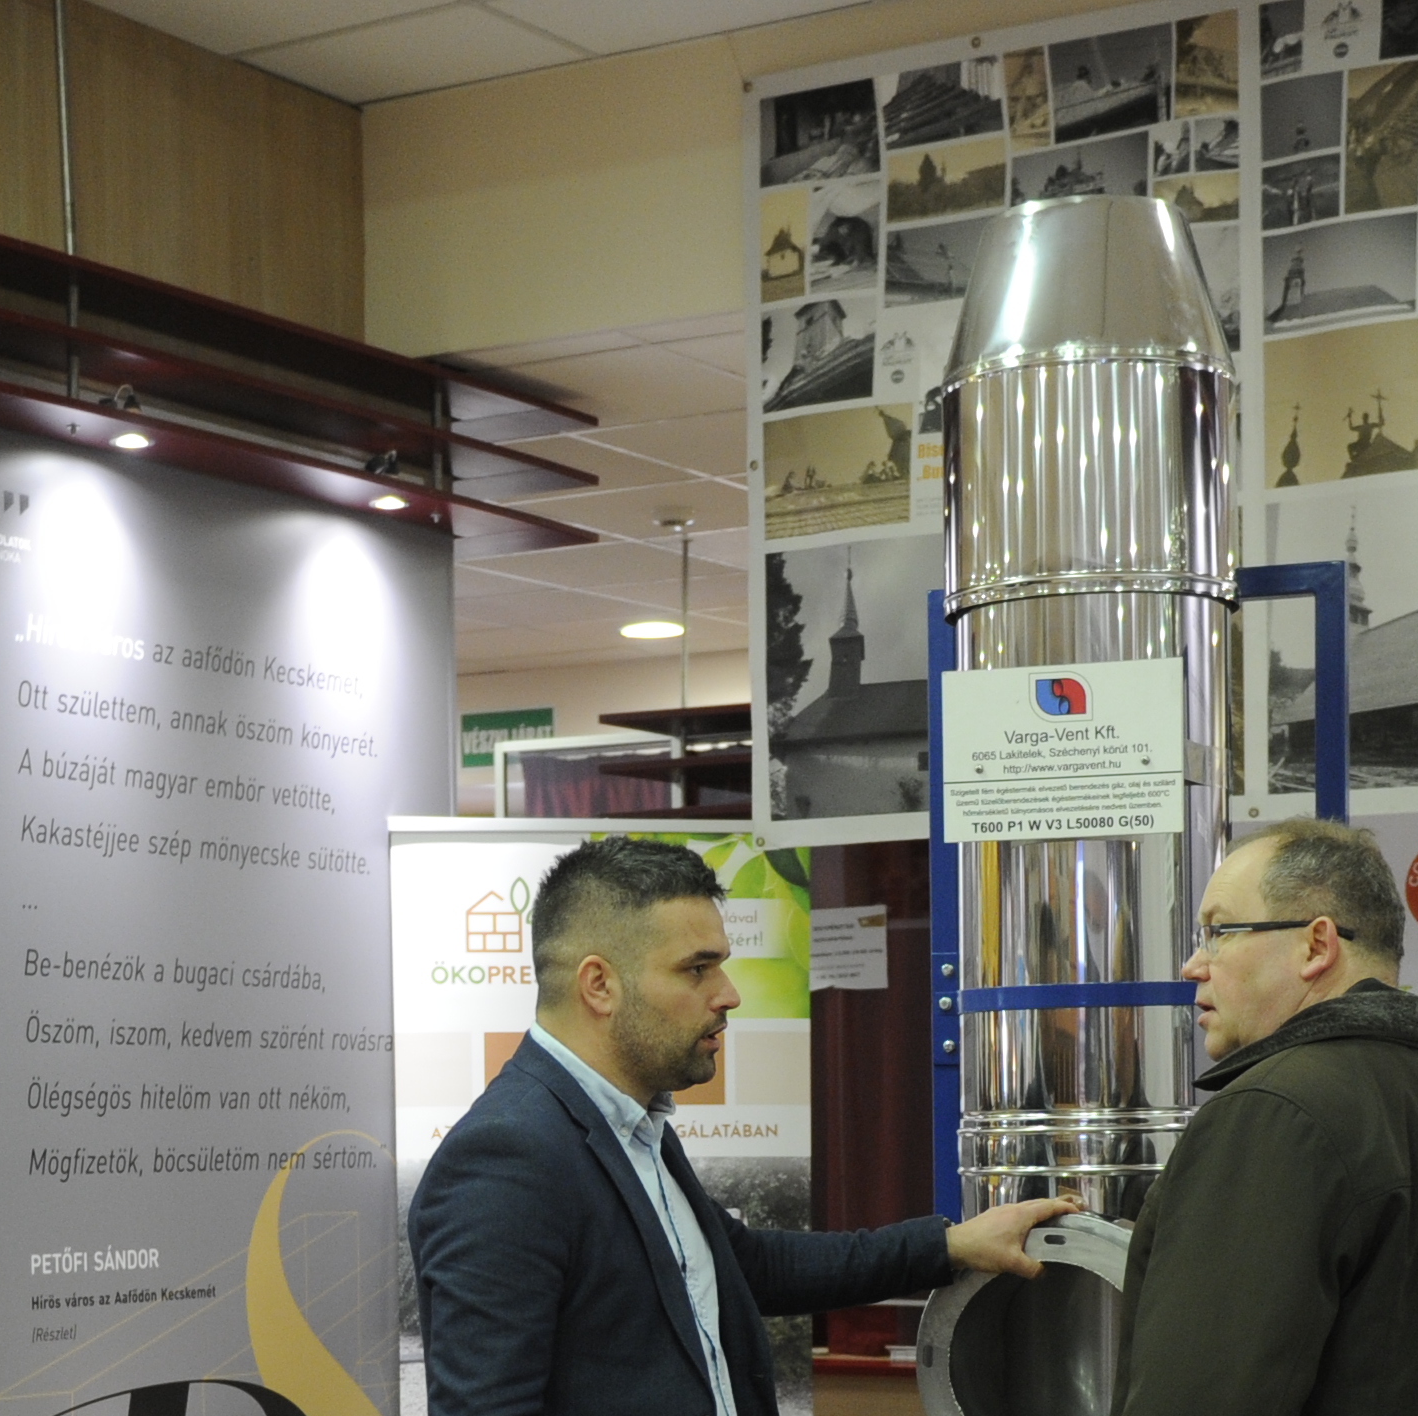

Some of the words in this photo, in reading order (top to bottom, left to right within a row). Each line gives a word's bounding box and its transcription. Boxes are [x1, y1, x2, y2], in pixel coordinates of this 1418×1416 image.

[152, 642, 175, 666] az
[182, 645, 255, 679] aafődön
[17, 679, 48, 711] Ott
[56, 690, 161, 731] születtem,
[170, 710, 227, 737] annak
[236, 714, 294, 747] öszöm
[301, 722, 379, 759] könyerét.
[1004, 727, 1089, 747] Varga-Vent
[1095, 725, 1120, 741] Kft.
[971, 751, 997, 762] 6065
[999, 747, 1046, 761] Lakitelek,
[1049, 745, 1101, 760] Széchenyi
[1103, 744, 1128, 756] körút
[1132, 744, 1153, 754] 101.
[1003, 760, 1122, 776] http://www.vargavent.hu
[17, 747, 33, 776] A
[42, 750, 116, 791] búzáját
[124, 767, 198, 800] magyar
[205, 775, 266, 804] embör
[272, 783, 336, 815] vetötte,
[971, 822, 1003, 834] T600
[1007, 820, 1024, 832] P1
[1028, 820, 1042, 831] W
[1045, 818, 1062, 830] V3
[1066, 815, 1114, 830] L50080
[1118, 814, 1154, 829] G(50)
[21, 814, 140, 859] Kakastéjjee
[147, 829, 192, 865] szép
[200, 835, 301, 870] mönyecske
[307, 846, 371, 876] sütötte.
[24, 948, 145, 982] Be-benézök
[153, 961, 165, 983] a
[173, 957, 235, 993] bugaci
[241, 961, 327, 994] csárdába,
[431, 960, 538, 985] ÖKOPRE
[109, 1018, 172, 1050] iszom,
[181, 1021, 252, 1049] kedvem
[259, 1024, 325, 1051] szörént
[27, 1076, 132, 1118] Ölégségös
[140, 1083, 211, 1110] hitelöm
[219, 1089, 251, 1110] van
[257, 1086, 282, 1110] ott
[288, 1084, 351, 1114] néköm,
[29, 1146, 144, 1183] Mögfizetök,
[153, 1145, 260, 1174] böcsületöm
[267, 1150, 306, 1172] nem
[31, 1246, 88, 1275] PETŐFI
[94, 1245, 159, 1272] SÁNDOR
[65, 1292, 94, 1308] város
[98, 1295, 111, 1306] az
[161, 1283, 216, 1302] Kecskemét
